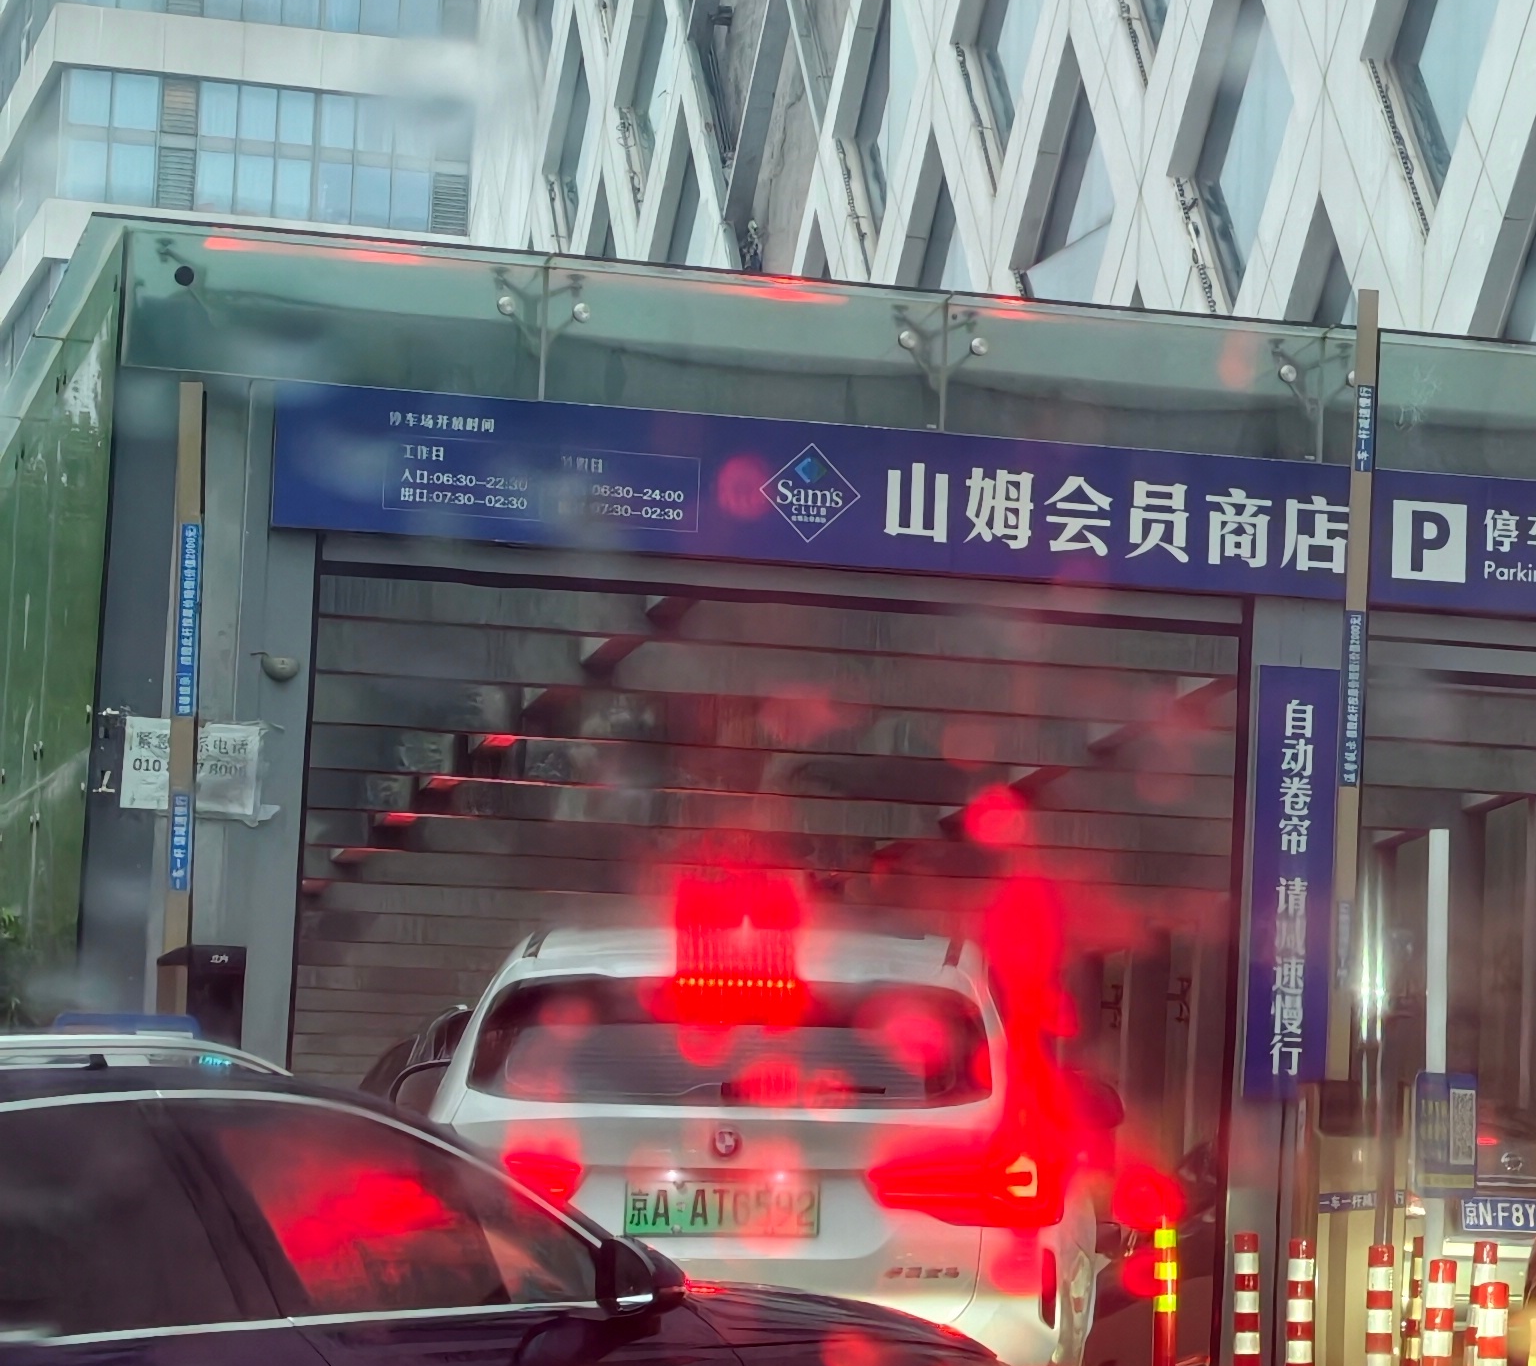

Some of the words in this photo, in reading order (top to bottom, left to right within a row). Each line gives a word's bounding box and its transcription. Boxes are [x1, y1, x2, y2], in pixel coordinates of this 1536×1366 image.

[389, 411, 495, 433] 停车场开放时间
[403, 444, 444, 461] 工作日
[776, 479, 843, 508] Sam's
[791, 505, 827, 516] CLUB
[883, 462, 1350, 574] 山姆会员商店
[1410, 509, 1451, 573] P
[137, 731, 249, 755] 紧急系电话
[133, 758, 162, 772] 010
[1279, 700, 1314, 855] 自动卷帘
[629, 1188, 670, 1227] 京A
